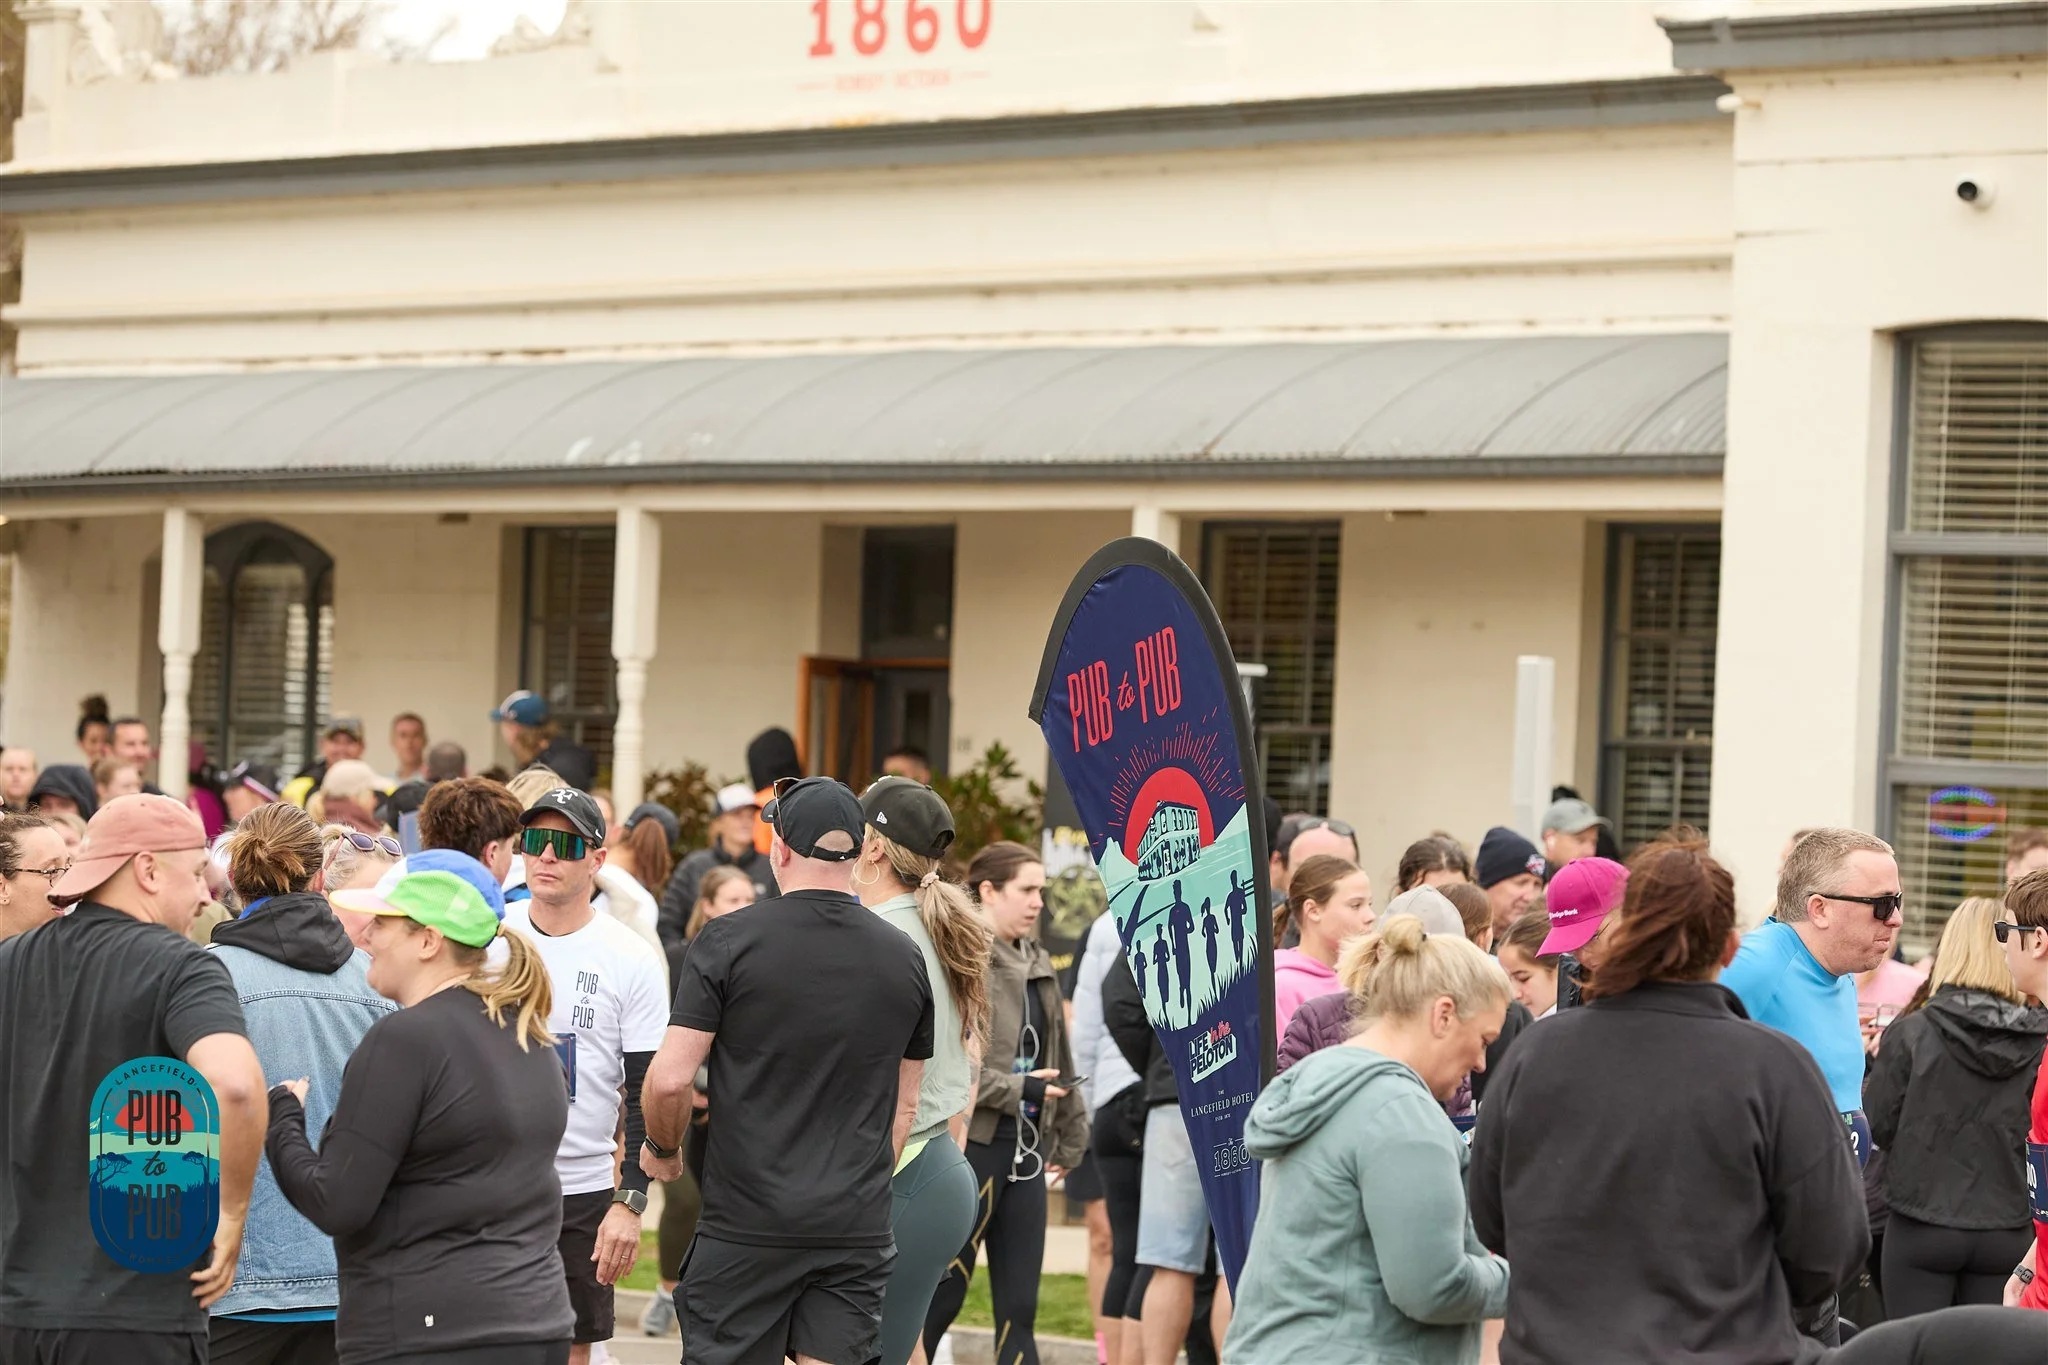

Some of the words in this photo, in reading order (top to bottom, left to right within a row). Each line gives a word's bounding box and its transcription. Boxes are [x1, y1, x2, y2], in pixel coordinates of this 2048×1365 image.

[808, 0, 992, 56] 1860
[1067, 660, 1113, 753] PUB
[1116, 671, 1136, 711] to
[1134, 626, 1182, 724] PUB
[575, 970, 599, 995] PUB
[580, 995, 590, 1005] to
[571, 1005, 595, 1030] PUB
[1189, 1031, 1209, 1059] LIFE
[1190, 1034, 1234, 1078] PELOTON
[1190, 1098, 1230, 1118] LANCEFIELD
[1231, 1091, 1255, 1106] HOTEL
[1214, 1142, 1251, 1172] 1860
